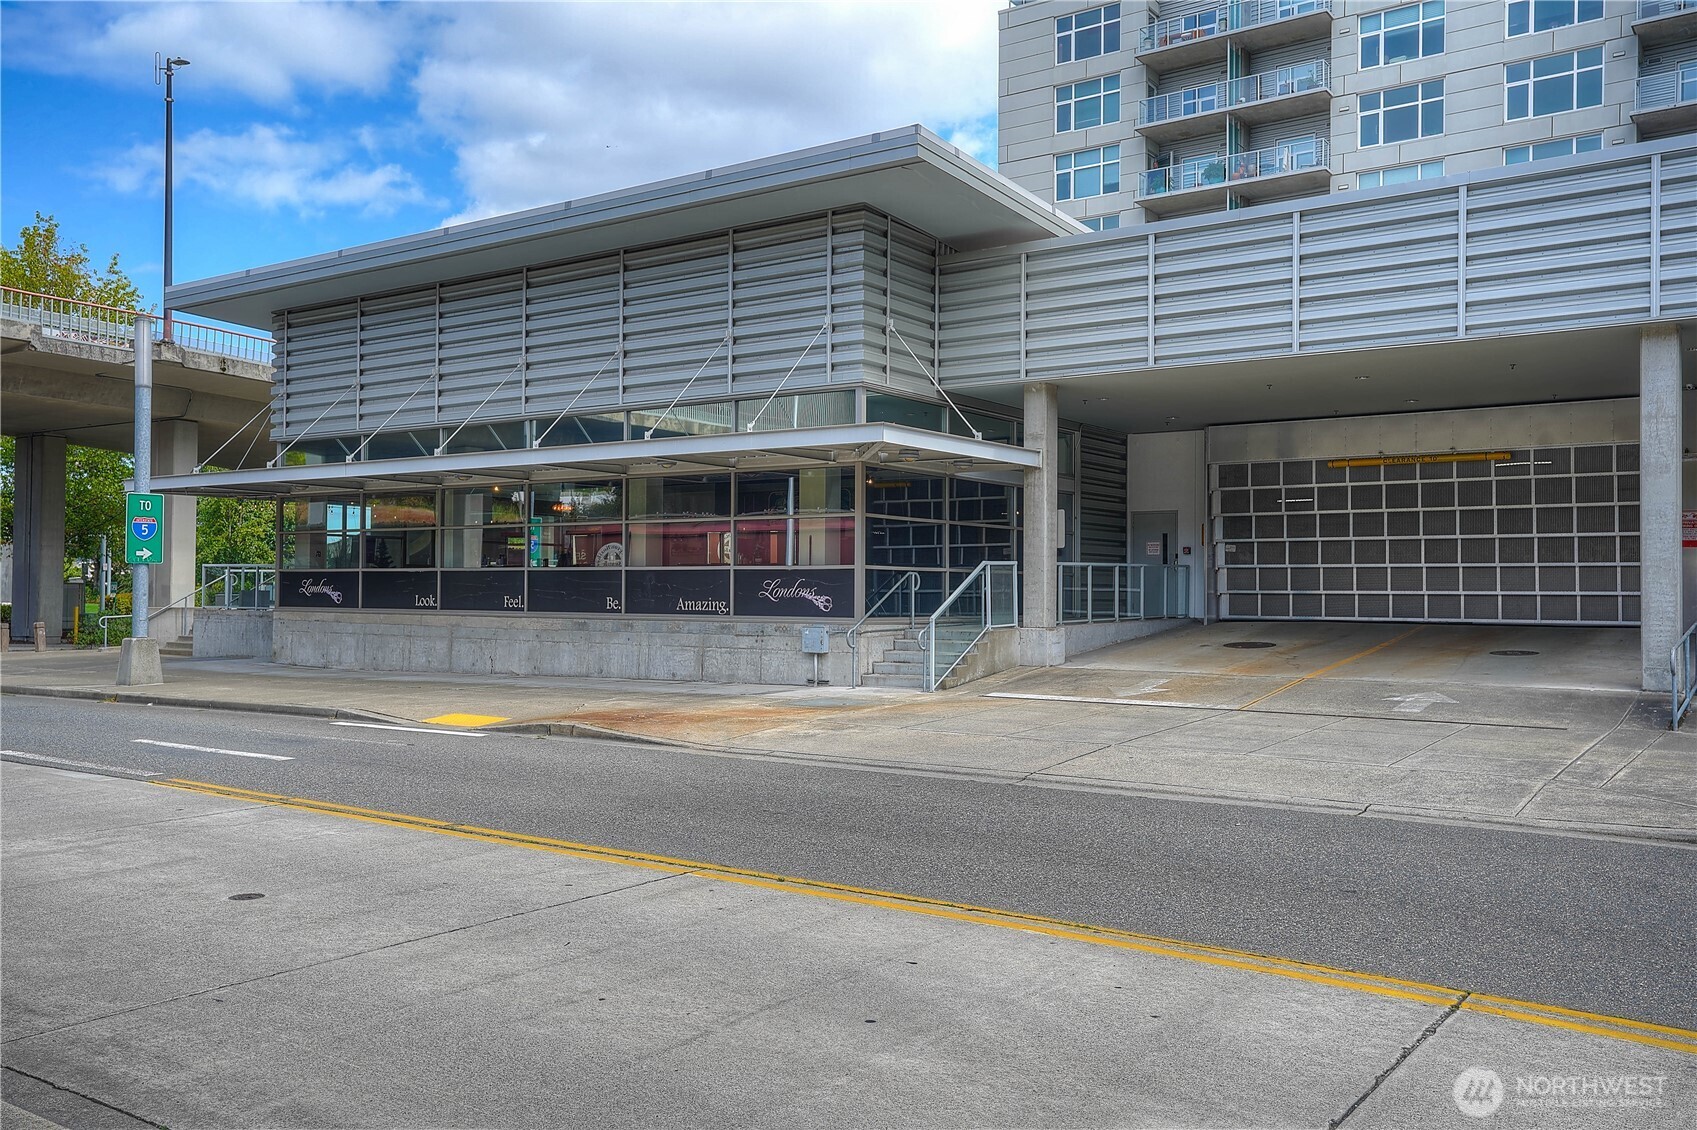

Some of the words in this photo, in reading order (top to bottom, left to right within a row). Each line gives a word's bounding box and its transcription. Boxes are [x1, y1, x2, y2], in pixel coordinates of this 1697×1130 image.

[1382, 456, 1426, 464] CLEARANCE
[139, 500, 152, 511] TO
[141, 524, 149, 536] 5
[758, 578, 818, 602] Londons
[415, 594, 438, 606] Look.
[503, 595, 524, 608] Feel.
[606, 597, 621, 610] Be.
[676, 598, 729, 614] Amazing.
